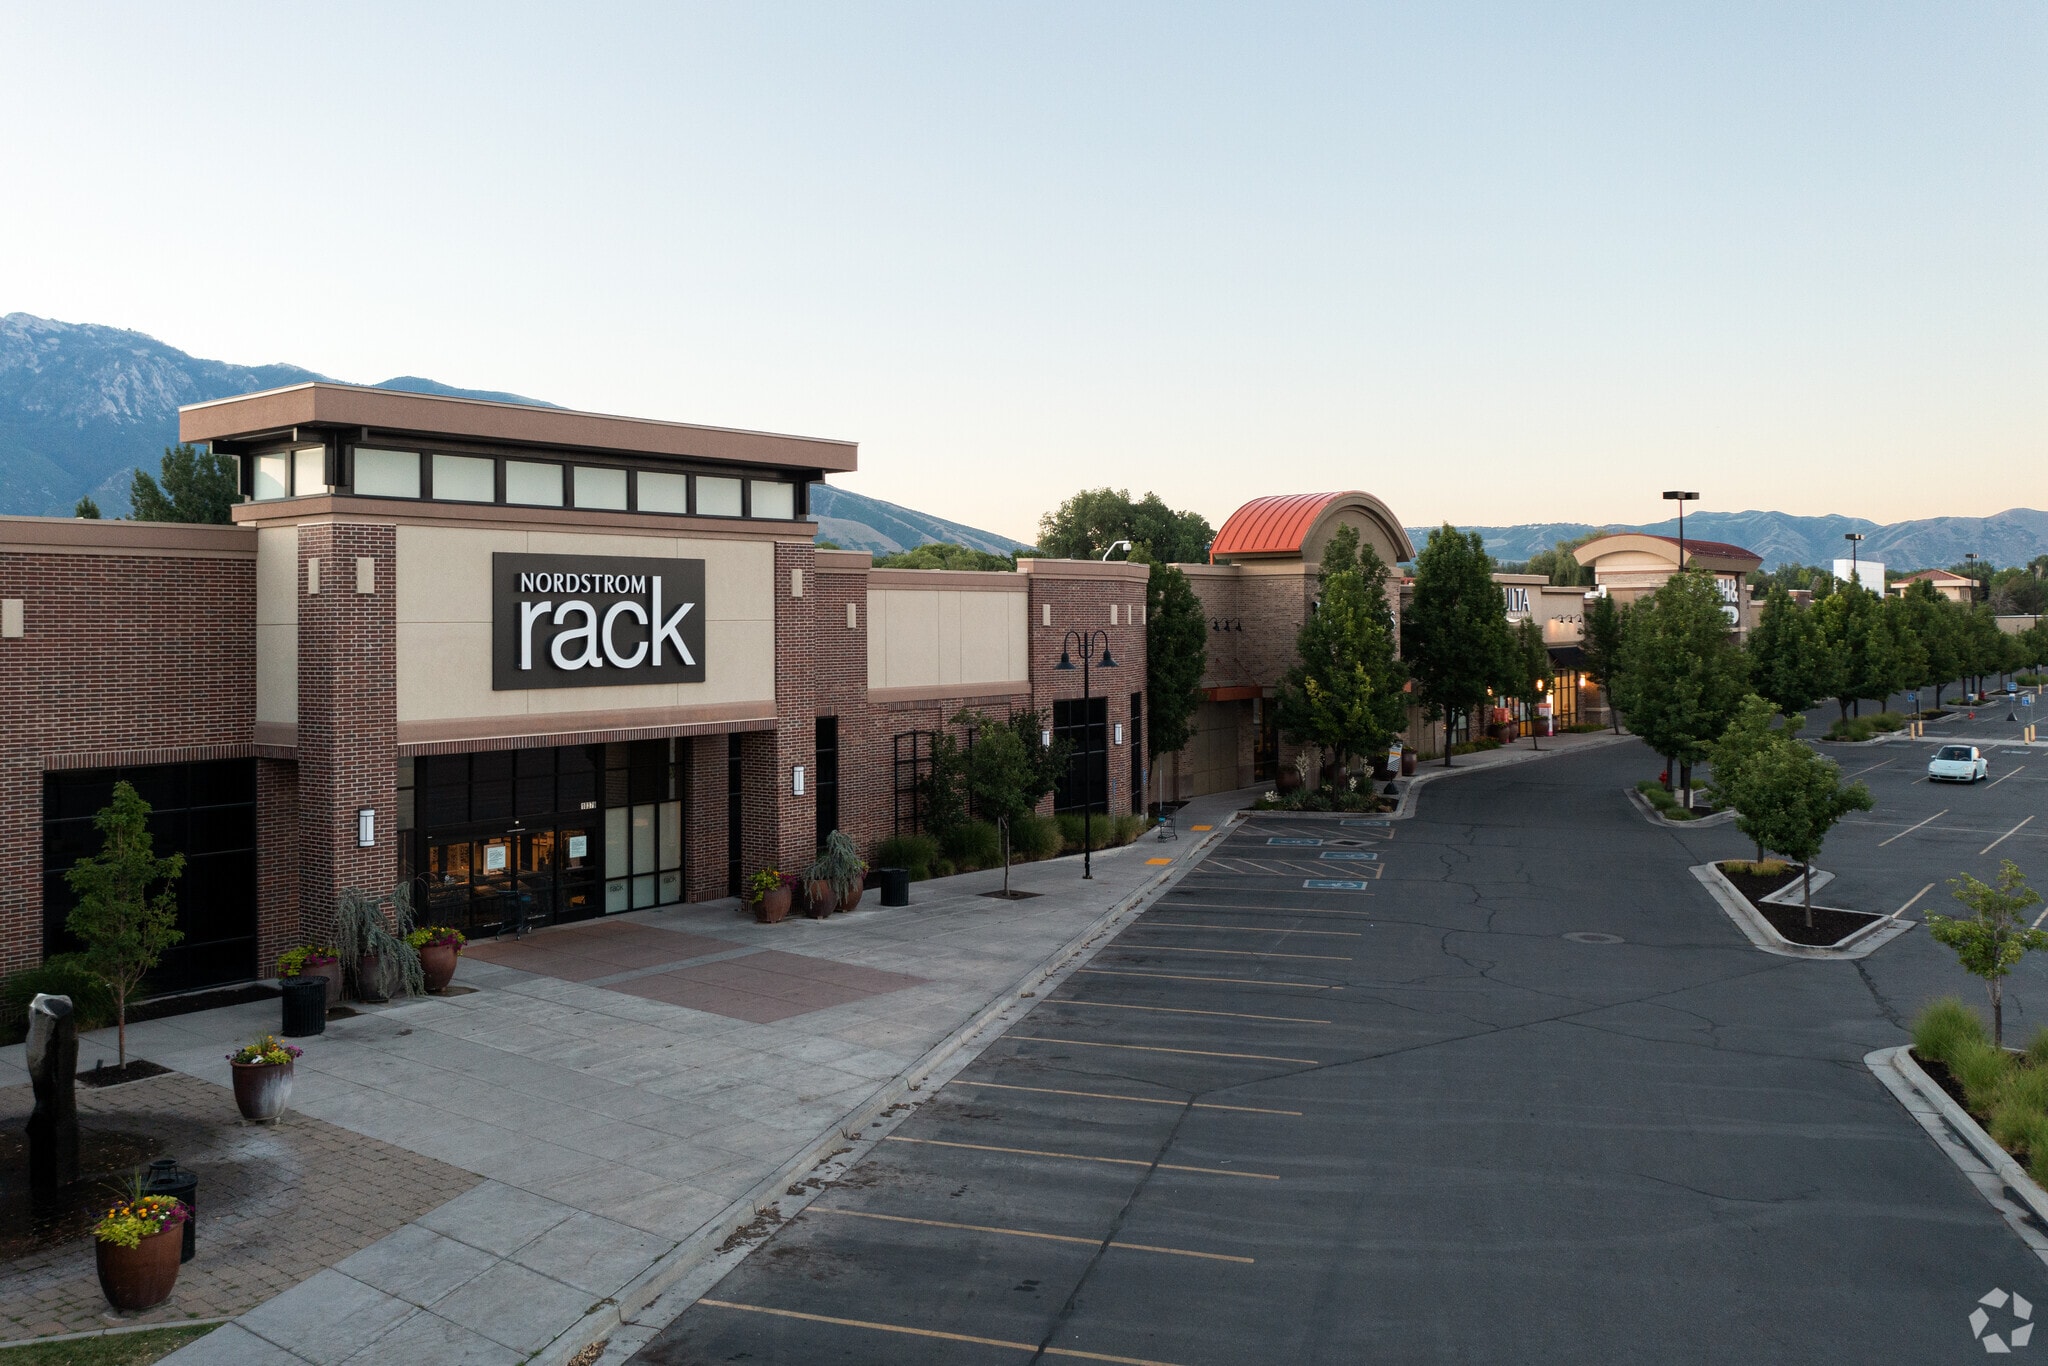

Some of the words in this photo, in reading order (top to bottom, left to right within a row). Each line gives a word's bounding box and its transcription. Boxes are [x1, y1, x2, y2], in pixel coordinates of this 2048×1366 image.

[520, 572, 646, 594] NORDSTROM
[1503, 588, 1530, 611] ULTA
[520, 576, 696, 670] rack
[609, 883, 624, 892] rack
